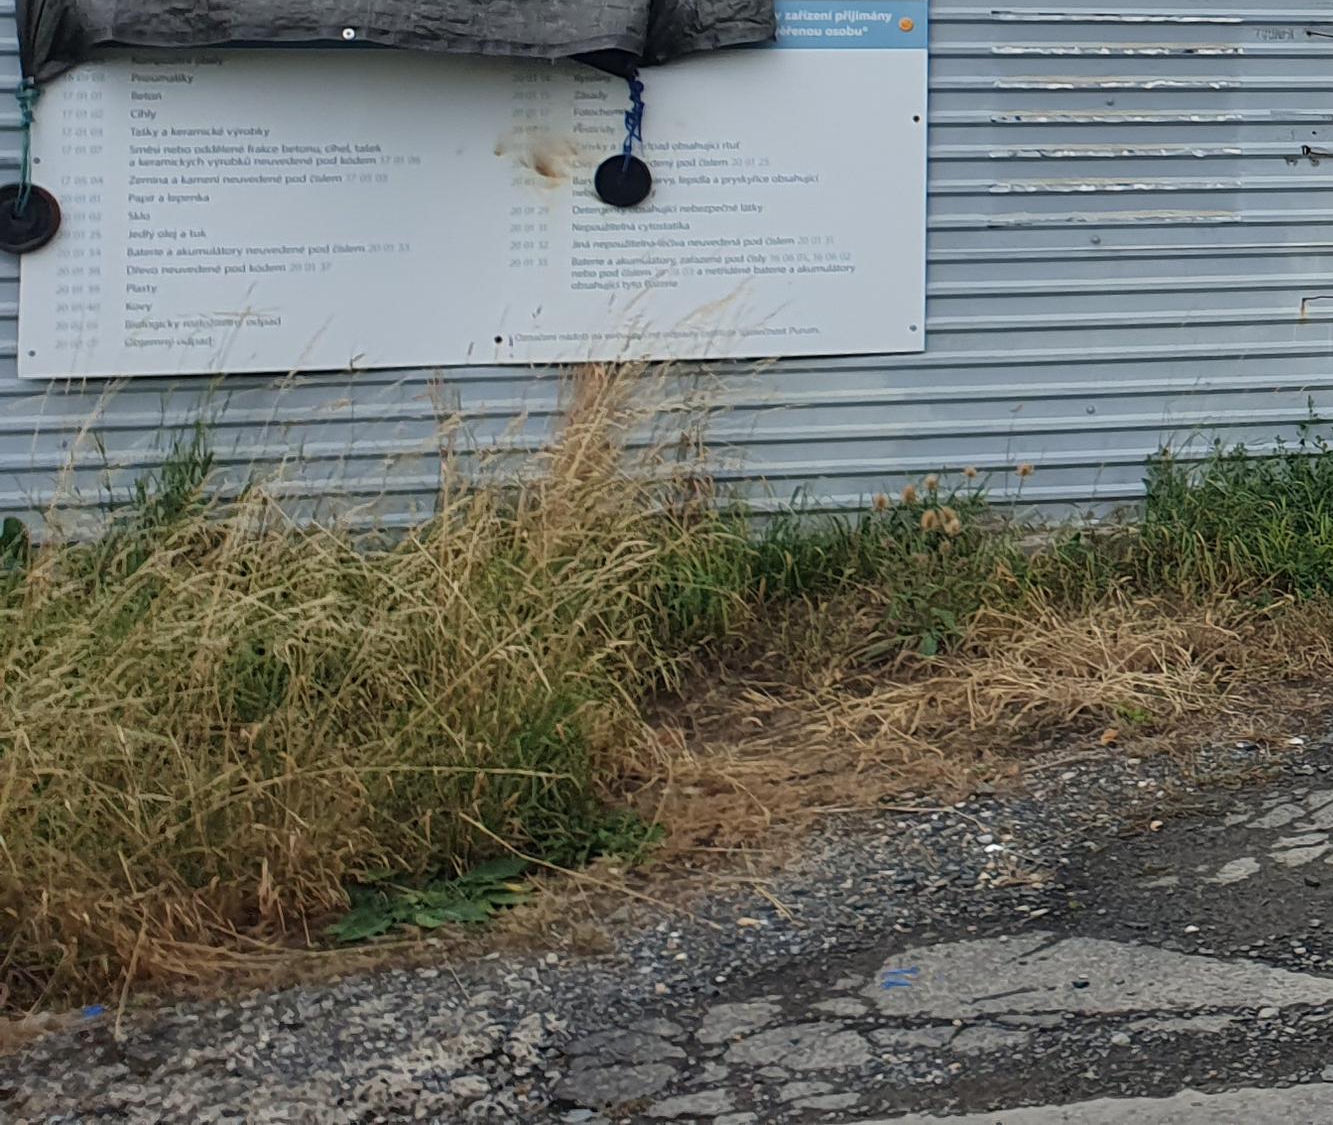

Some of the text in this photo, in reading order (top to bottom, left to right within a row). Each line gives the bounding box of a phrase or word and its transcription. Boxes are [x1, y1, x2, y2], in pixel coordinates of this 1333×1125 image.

[784, 10, 832, 20] zařízení
[835, 9, 893, 23] přijímány
[130, 109, 157, 121] Cihly
[130, 126, 270, 138] Tašky a keramické výrobky
[129, 155, 377, 169] a keramických výrobků neuvedené pod kódem
[676, 158, 696, 168] pod
[128, 175, 169, 185] Zemina
[171, 177, 178, 185] a
[223, 175, 282, 184] neuvedené
[285, 175, 306, 185] pod
[157, 229, 177, 240] olej
[176, 246, 242, 257] akumulátory
[246, 244, 305, 255] neuvedené
[308, 244, 330, 255] pod
[127, 264, 158, 275] Dřevo
[161, 264, 221, 275] neuvedené
[224, 264, 246, 276] pod
[126, 283, 157, 294] Plasty
[126, 302, 152, 312] Kovy
